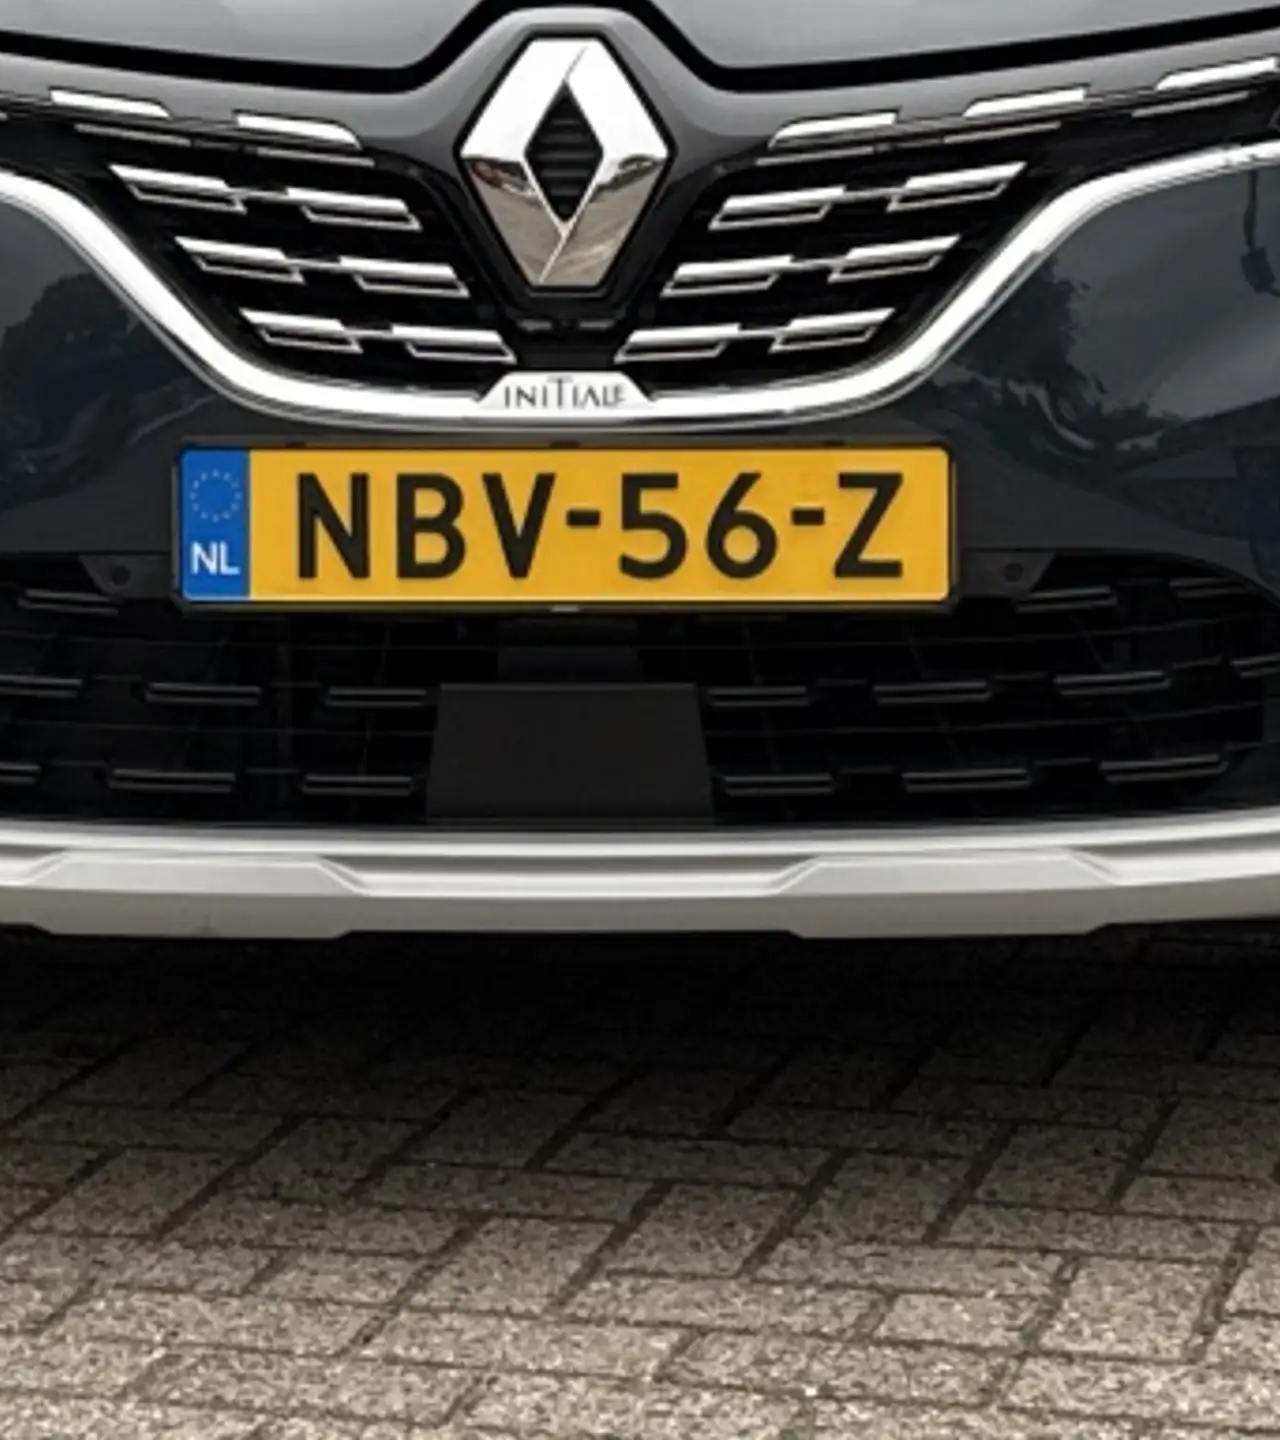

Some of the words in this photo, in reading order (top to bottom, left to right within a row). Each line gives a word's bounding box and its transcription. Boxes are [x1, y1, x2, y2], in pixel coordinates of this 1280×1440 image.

[504, 375, 626, 409] INITIALE
[297, 472, 904, 579] NBV-56-Z
[190, 541, 240, 575] NL
